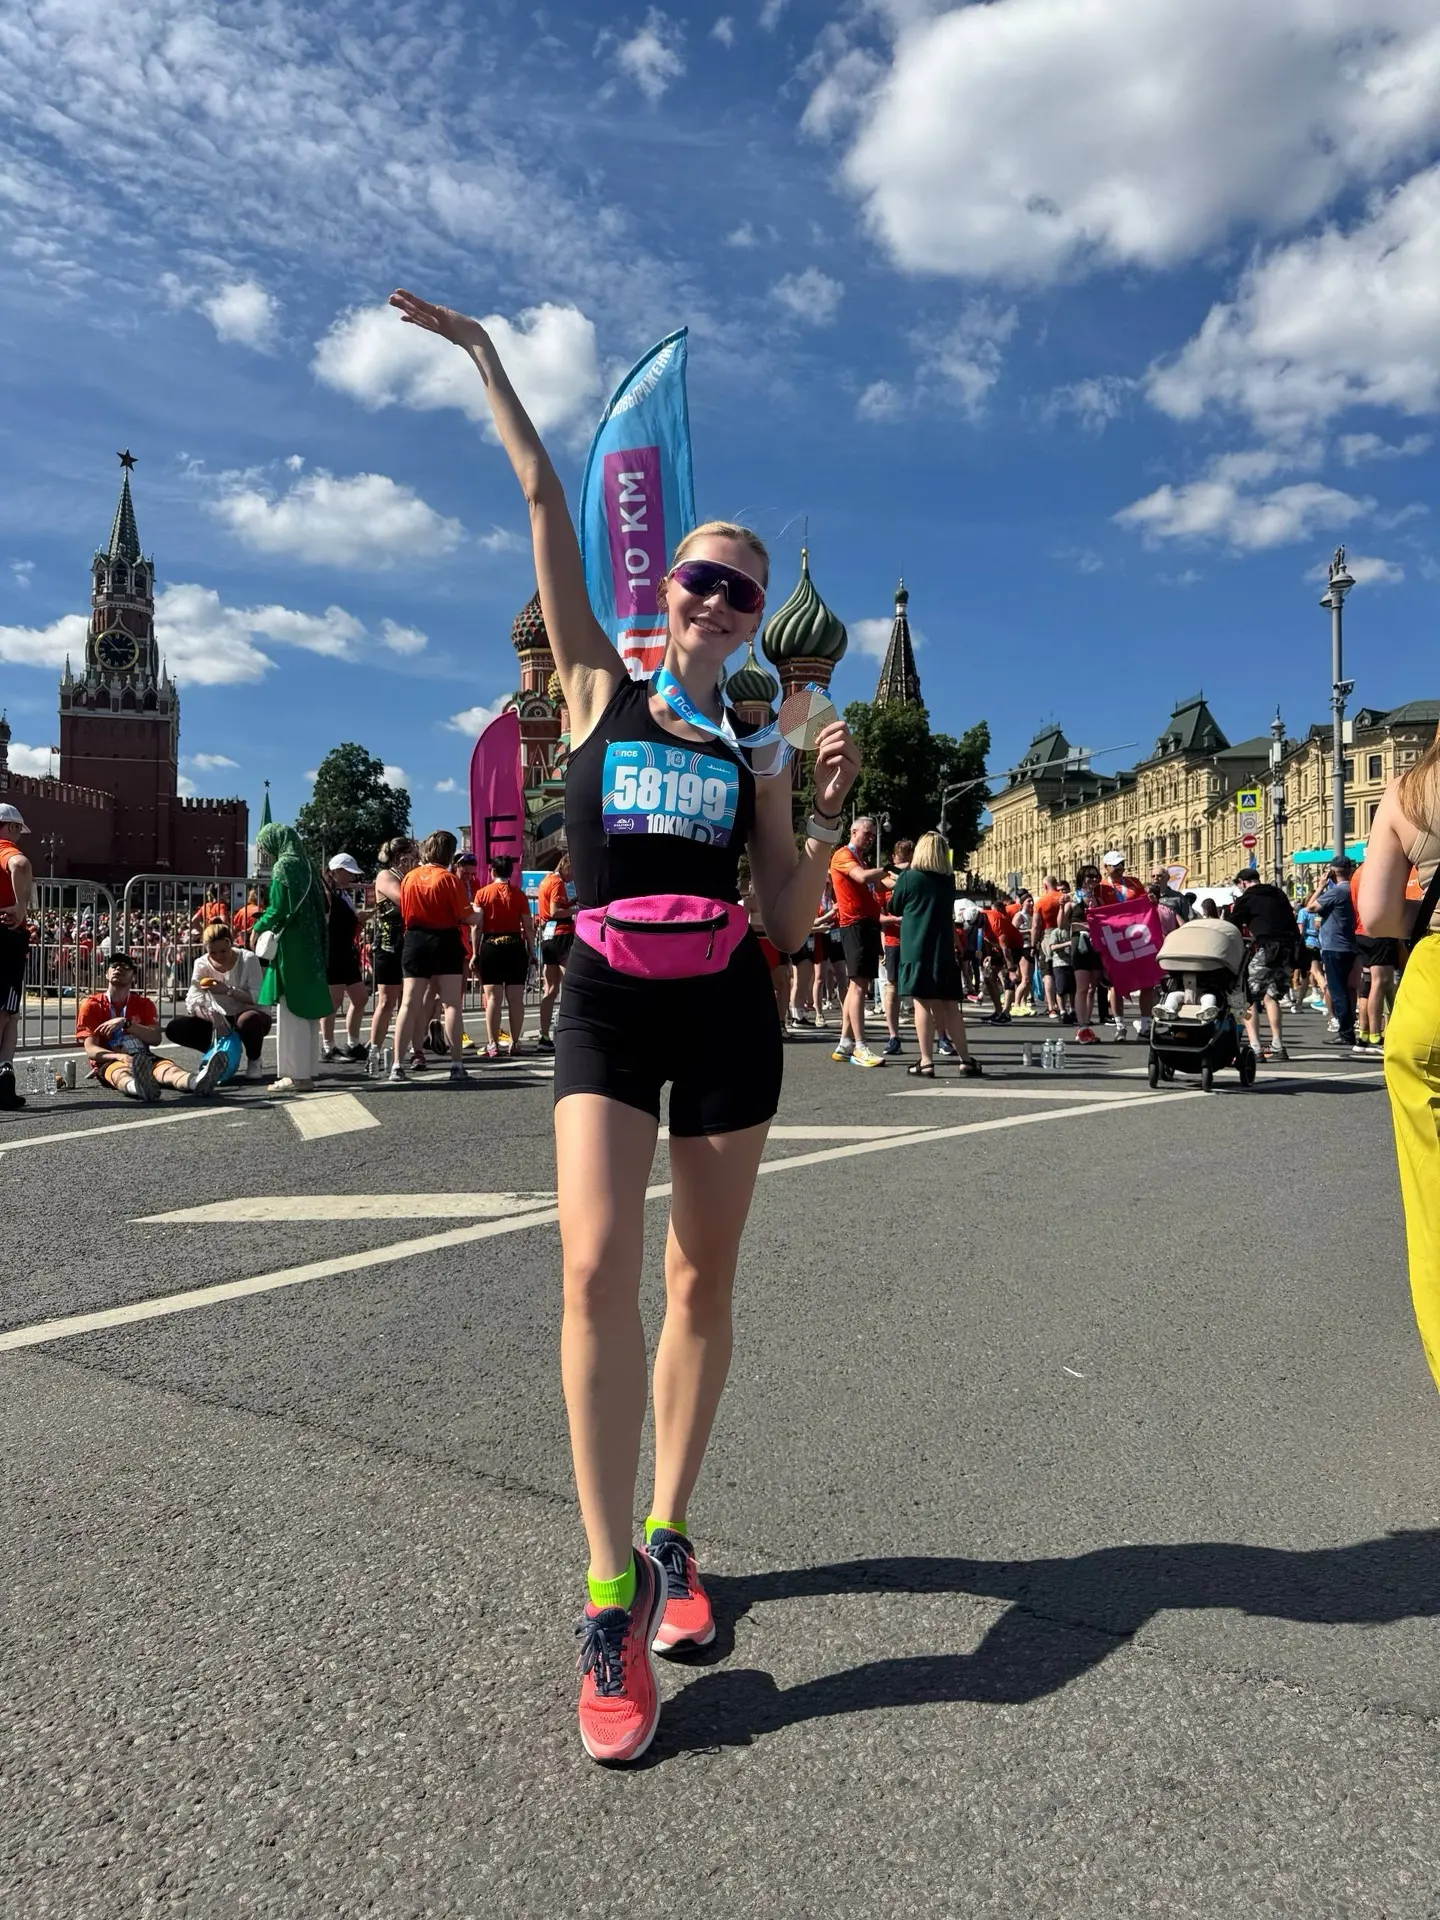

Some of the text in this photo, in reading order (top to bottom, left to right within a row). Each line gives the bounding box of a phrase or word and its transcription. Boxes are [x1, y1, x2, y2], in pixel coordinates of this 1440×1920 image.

[625, 548, 651, 594] 10
[673, 695, 697, 719] ПСБ
[620, 750, 639, 758] ПСБ
[613, 765, 727, 820] 58199
[1101, 923, 1158, 962] t2
